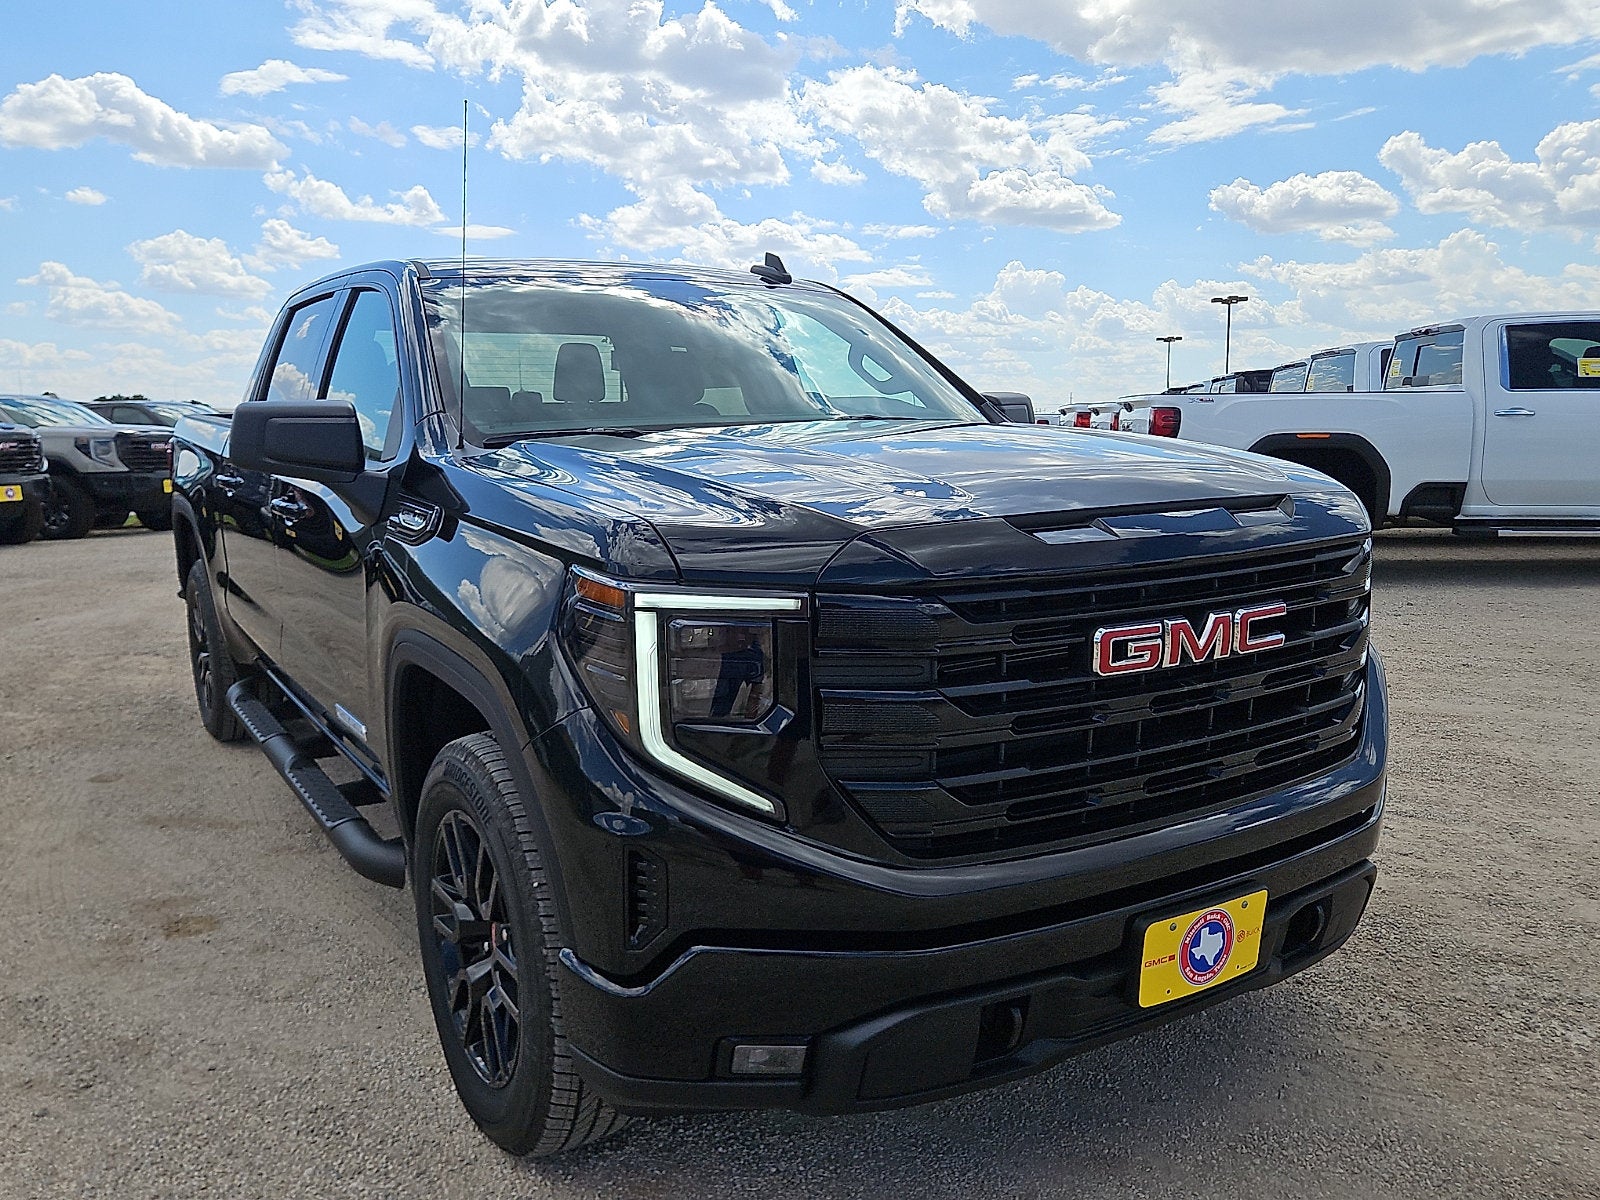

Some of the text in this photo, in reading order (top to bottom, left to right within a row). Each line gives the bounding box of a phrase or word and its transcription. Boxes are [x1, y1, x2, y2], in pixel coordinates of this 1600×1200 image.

[1093, 602, 1287, 676] GMC
[443, 759, 492, 826] BRIDGESTONE
[1206, 912, 1222, 921] Buick
[1144, 956, 1168, 968] GMC
[1185, 966, 1194, 978] San
